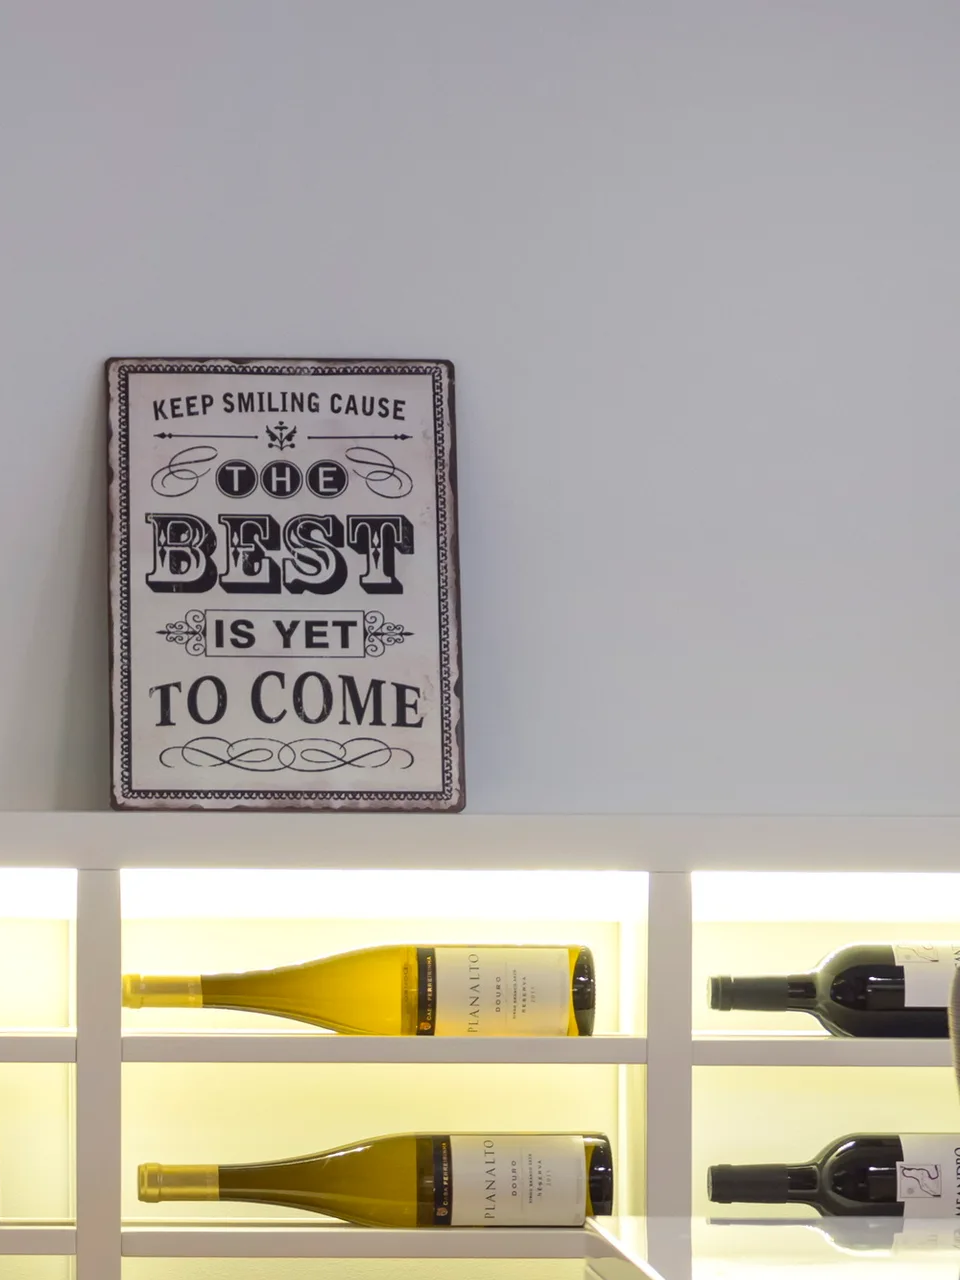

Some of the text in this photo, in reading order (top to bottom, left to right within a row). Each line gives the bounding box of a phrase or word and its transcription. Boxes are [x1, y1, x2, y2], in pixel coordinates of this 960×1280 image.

[152, 391, 407, 421] KEEP SMILING CAUSE
[221, 463, 342, 494] THE
[144, 512, 415, 595] BEST
[215, 620, 358, 649] IS YET
[149, 670, 426, 729] TO COME
[467, 953, 480, 1033] PLANALTO
[484, 1139, 496, 1219] PLANALTO
